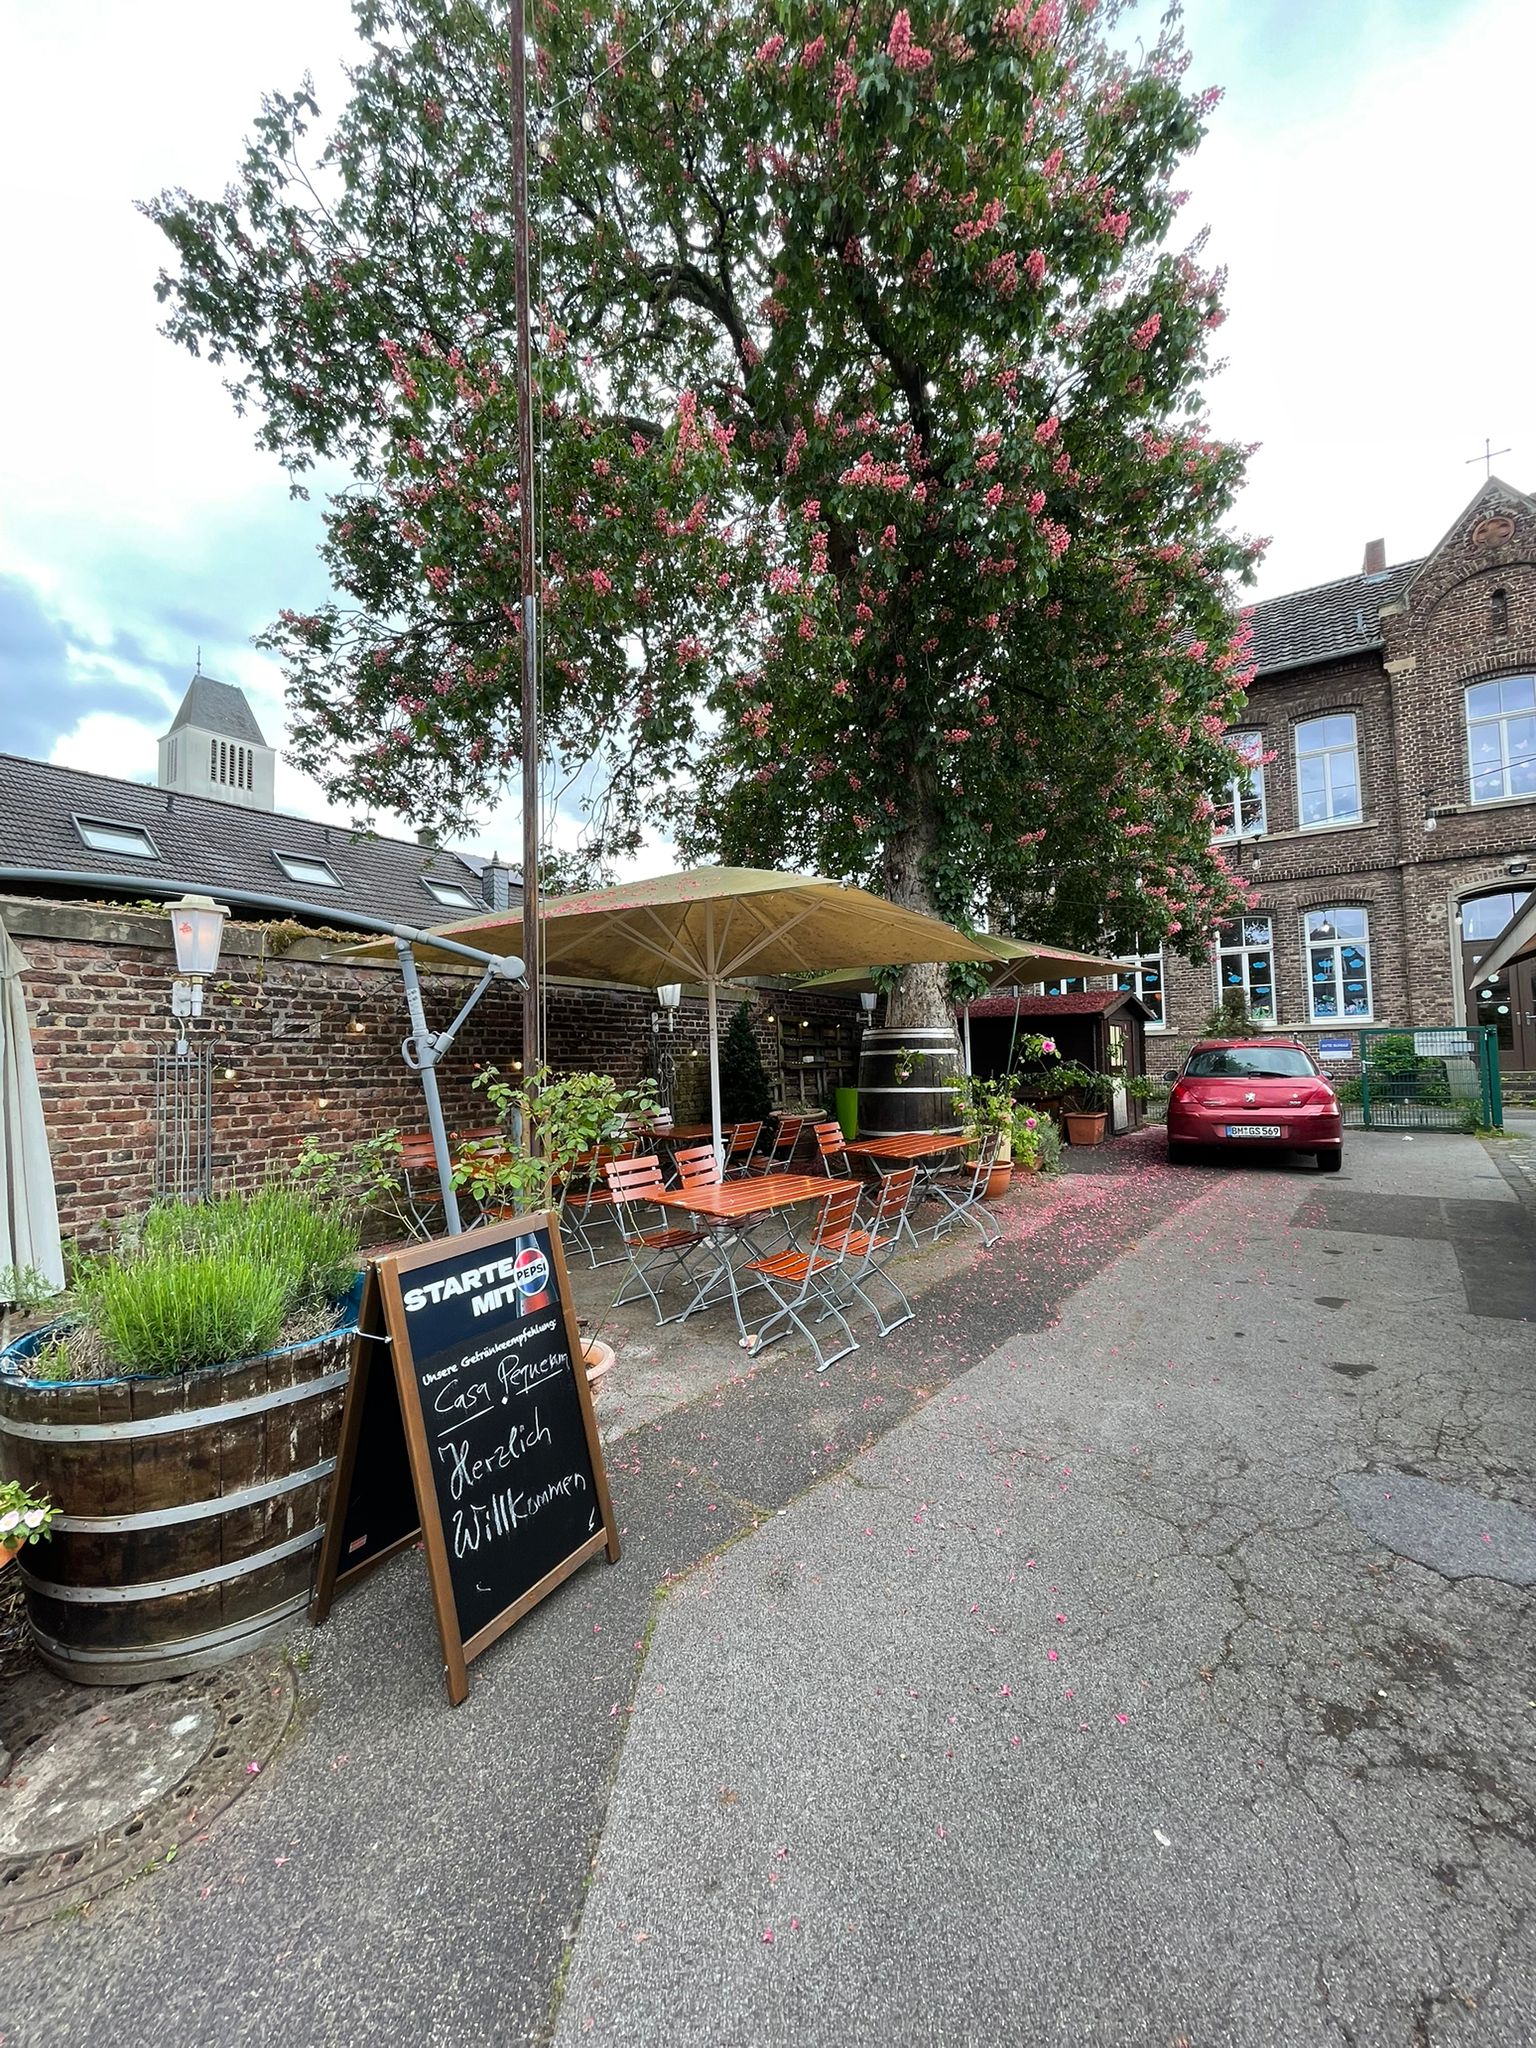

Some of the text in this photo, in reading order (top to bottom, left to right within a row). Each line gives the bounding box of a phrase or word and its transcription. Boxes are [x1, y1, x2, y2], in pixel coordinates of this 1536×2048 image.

[1248, 1127, 1261, 1136] GS
[1262, 1127, 1279, 1136] 569
[403, 1256, 515, 1312] STARTE
[516, 1262, 547, 1281] PEPSI
[471, 1282, 518, 1318] MIT
[422, 1363, 459, 1386] Unsere
[434, 1378, 492, 1413] Casa
[437, 1406, 552, 1500] Herzlich
